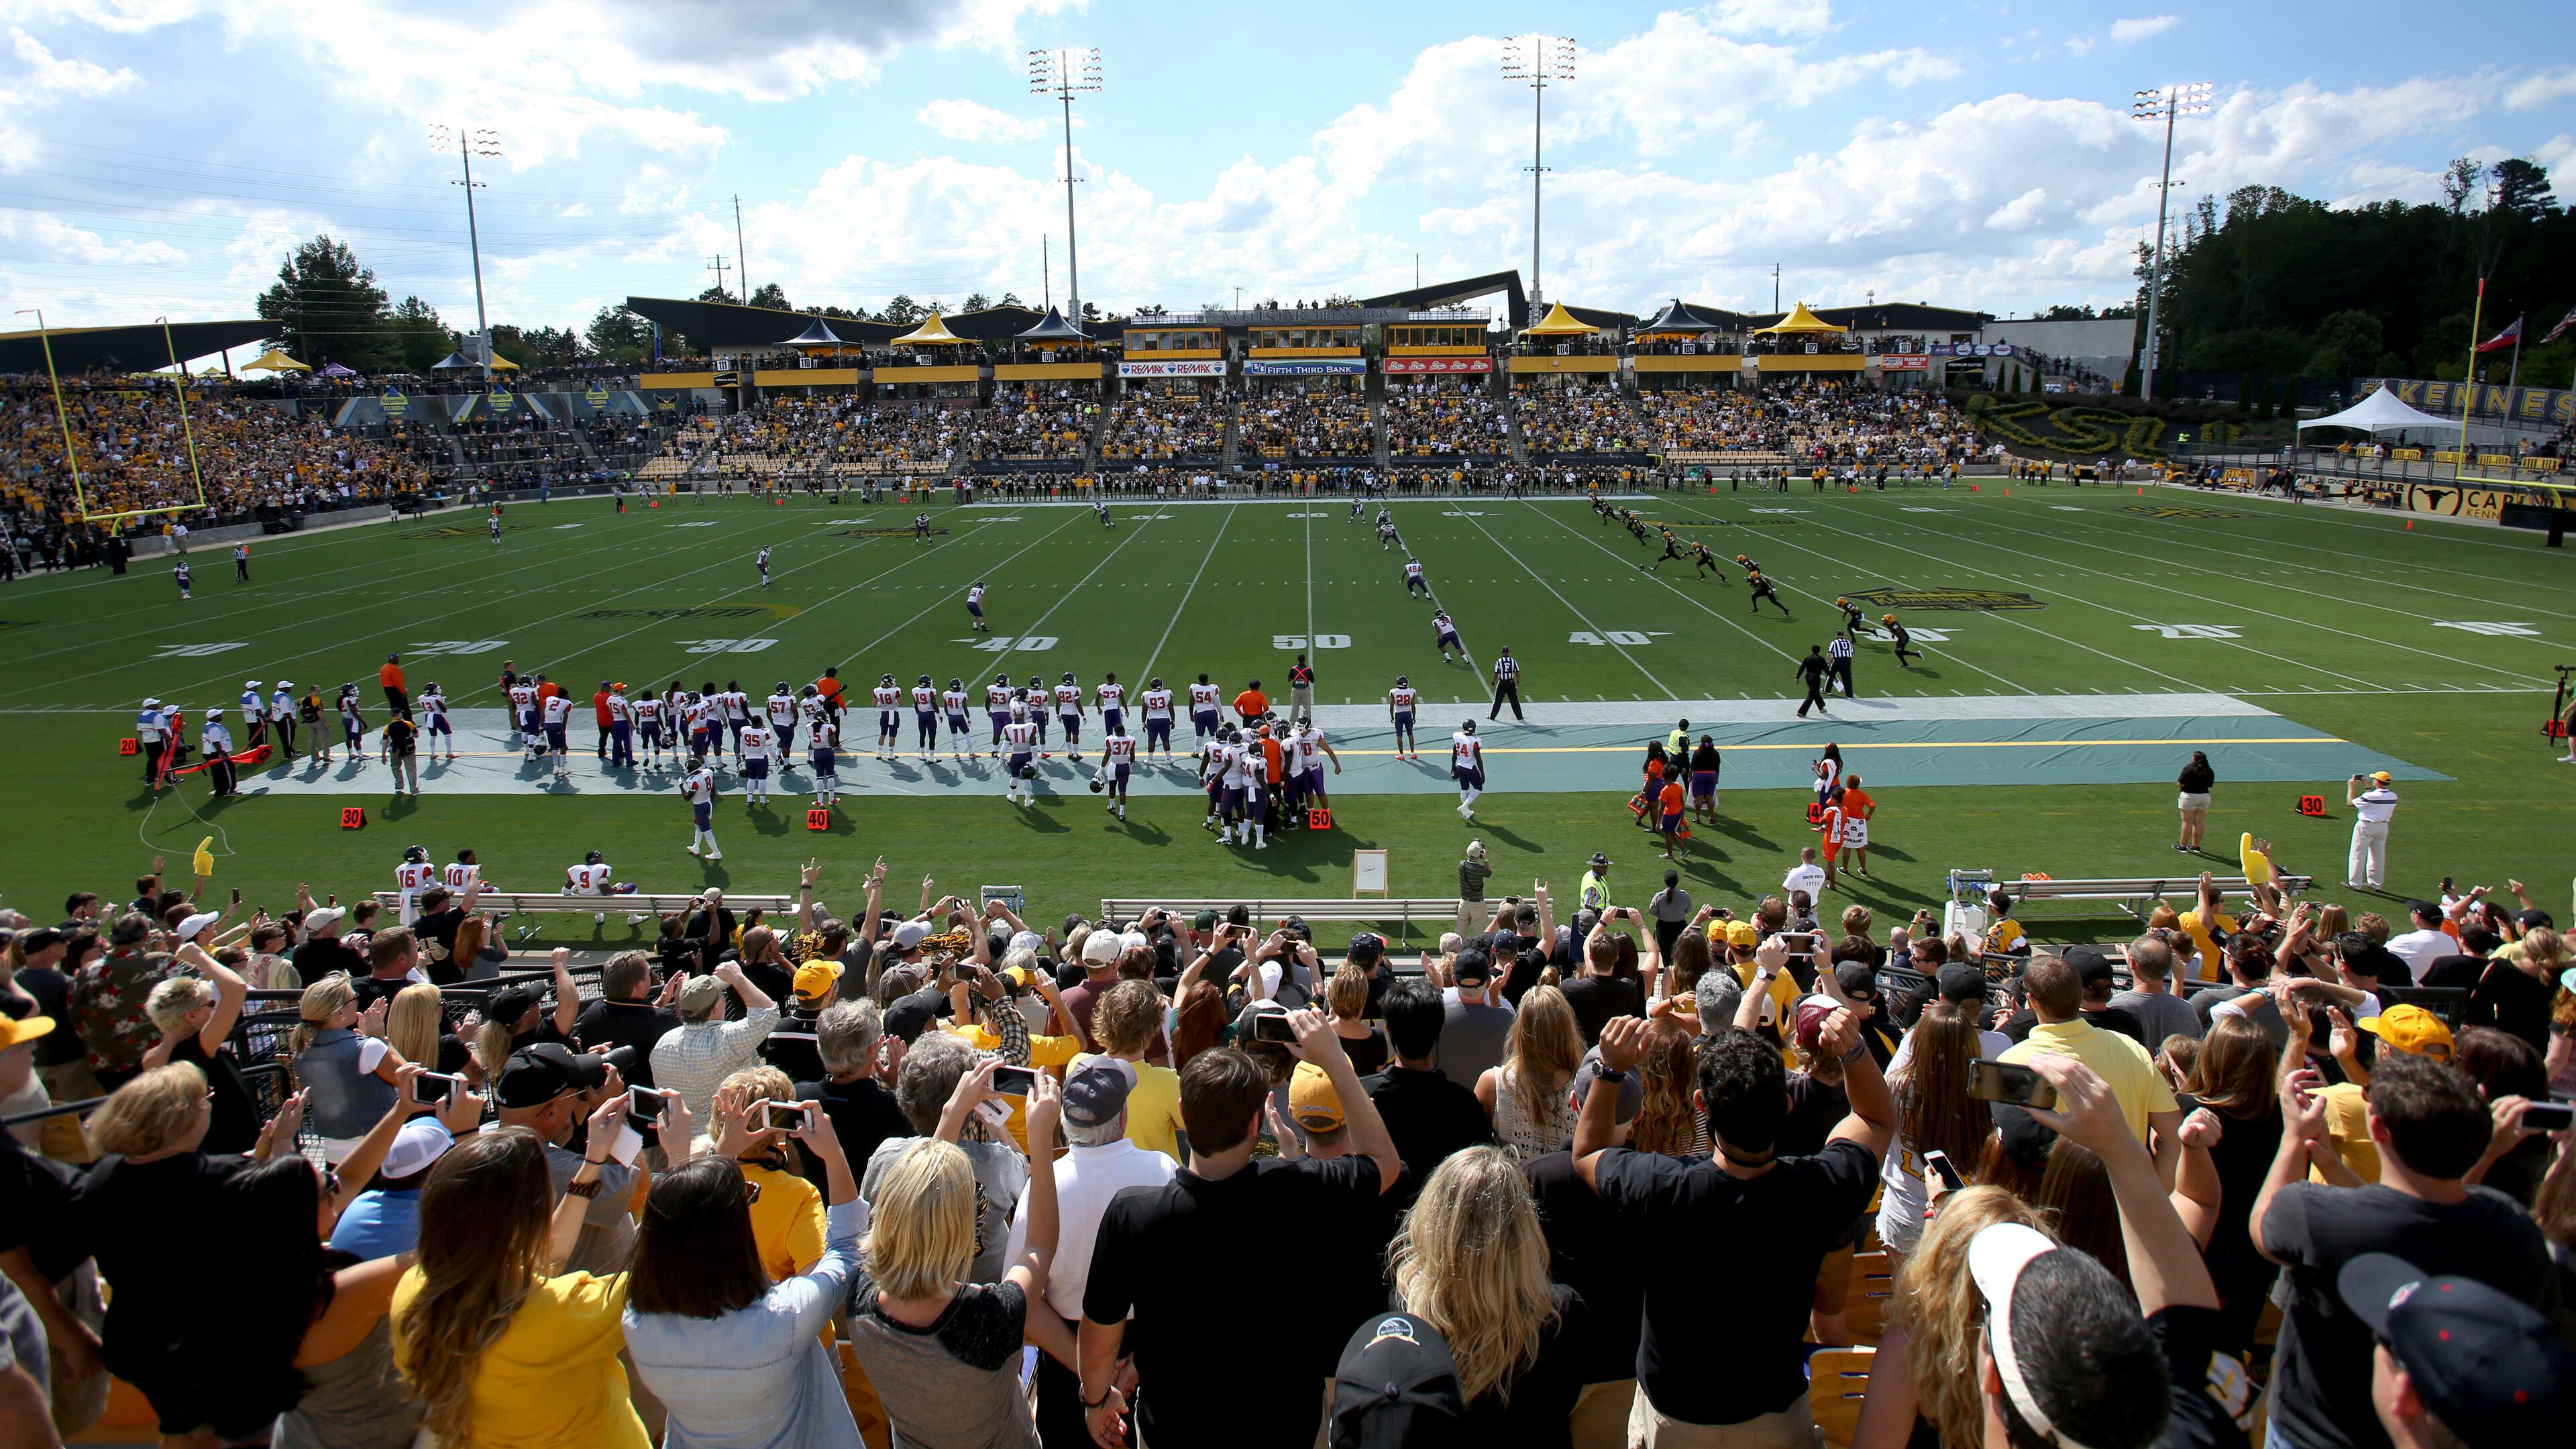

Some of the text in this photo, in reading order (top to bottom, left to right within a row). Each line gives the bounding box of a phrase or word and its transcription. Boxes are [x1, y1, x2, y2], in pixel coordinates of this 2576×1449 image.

[1223, 309, 1391, 325] WELLSTAR PRESS BOX
[1558, 345, 1568, 354] 104
[1684, 345, 1694, 354] 103
[1806, 344, 1817, 353] 102
[1900, 343, 1911, 352] 101
[800, 359, 810, 368] 110
[1043, 352, 1053, 362] 108
[718, 362, 727, 370] 111
[1131, 364, 1165, 374] RE/MAX
[1177, 364, 1211, 374] RE/MAX
[2466, 508, 2500, 520] KENN
[2130, 624, 2243, 639] 20
[972, 637, 1059, 651] 40
[1272, 634, 1352, 649] 50
[1568, 631, 1652, 646] 40
[404, 641, 510, 655] 20
[685, 639, 778, 653] 30
[1841, 641, 1849, 651] U
[1503, 661, 1511, 673] F
[513, 692, 529, 705] 32
[723, 697, 737, 709] 44
[879, 693, 893, 704] 18
[914, 693, 928, 704] 19
[947, 697, 959, 709] 41
[991, 692, 1006, 704] 63
[1027, 695, 1042, 708] 29
[1058, 691, 1073, 703] 82
[1149, 696, 1166, 710] 93
[1195, 691, 1212, 704] 54
[1396, 694, 1411, 706] 28
[421, 702, 435, 712] 13
[549, 700, 561, 712] 2
[637, 704, 655, 718] 39
[771, 701, 786, 714] 57
[744, 733, 761, 747] 95
[813, 731, 822, 743] 5
[1013, 728, 1026, 743] 11
[121, 739, 134, 751] 20
[1112, 741, 1131, 755] 37
[1212, 749, 1222, 763] 5
[1811, 804, 1820, 818] 4
[2304, 797, 2322, 813] 30
[342, 809, 360, 824] 30
[808, 810, 826, 826] 40
[1311, 810, 1330, 826] 50
[399, 869, 416, 888] 16
[447, 869, 463, 887] 10
[580, 873, 590, 888] 9
